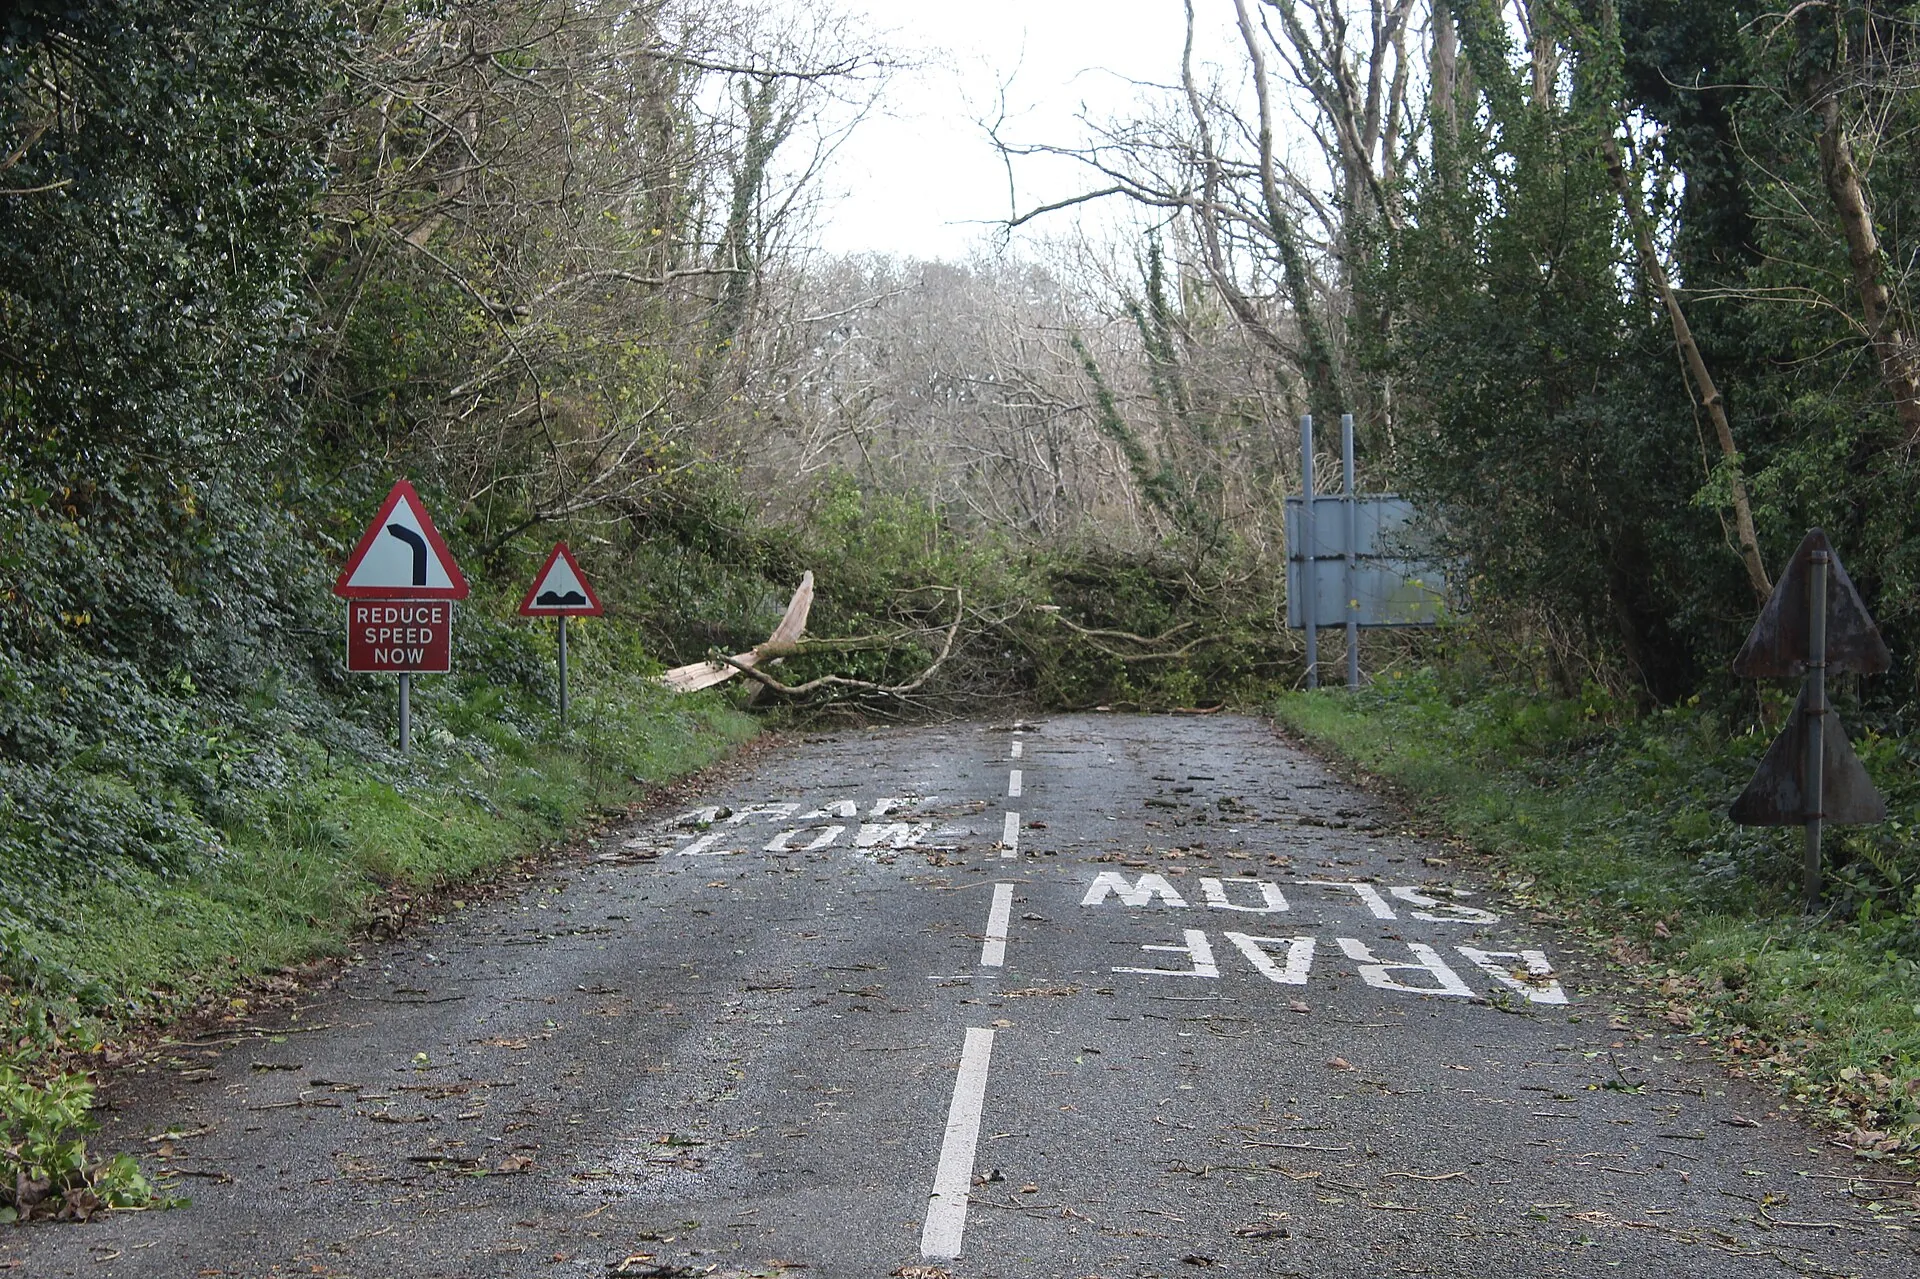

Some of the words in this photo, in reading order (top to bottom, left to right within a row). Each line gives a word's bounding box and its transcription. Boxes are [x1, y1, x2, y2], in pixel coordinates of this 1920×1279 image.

[357, 607, 442, 624] REDUCE
[365, 628, 433, 644] SPEED
[374, 647, 424, 664] NOW
[598, 822, 932, 861] SLOW
[1081, 872, 1500, 924] SLOW
[1112, 930, 1569, 1004] ARAF
